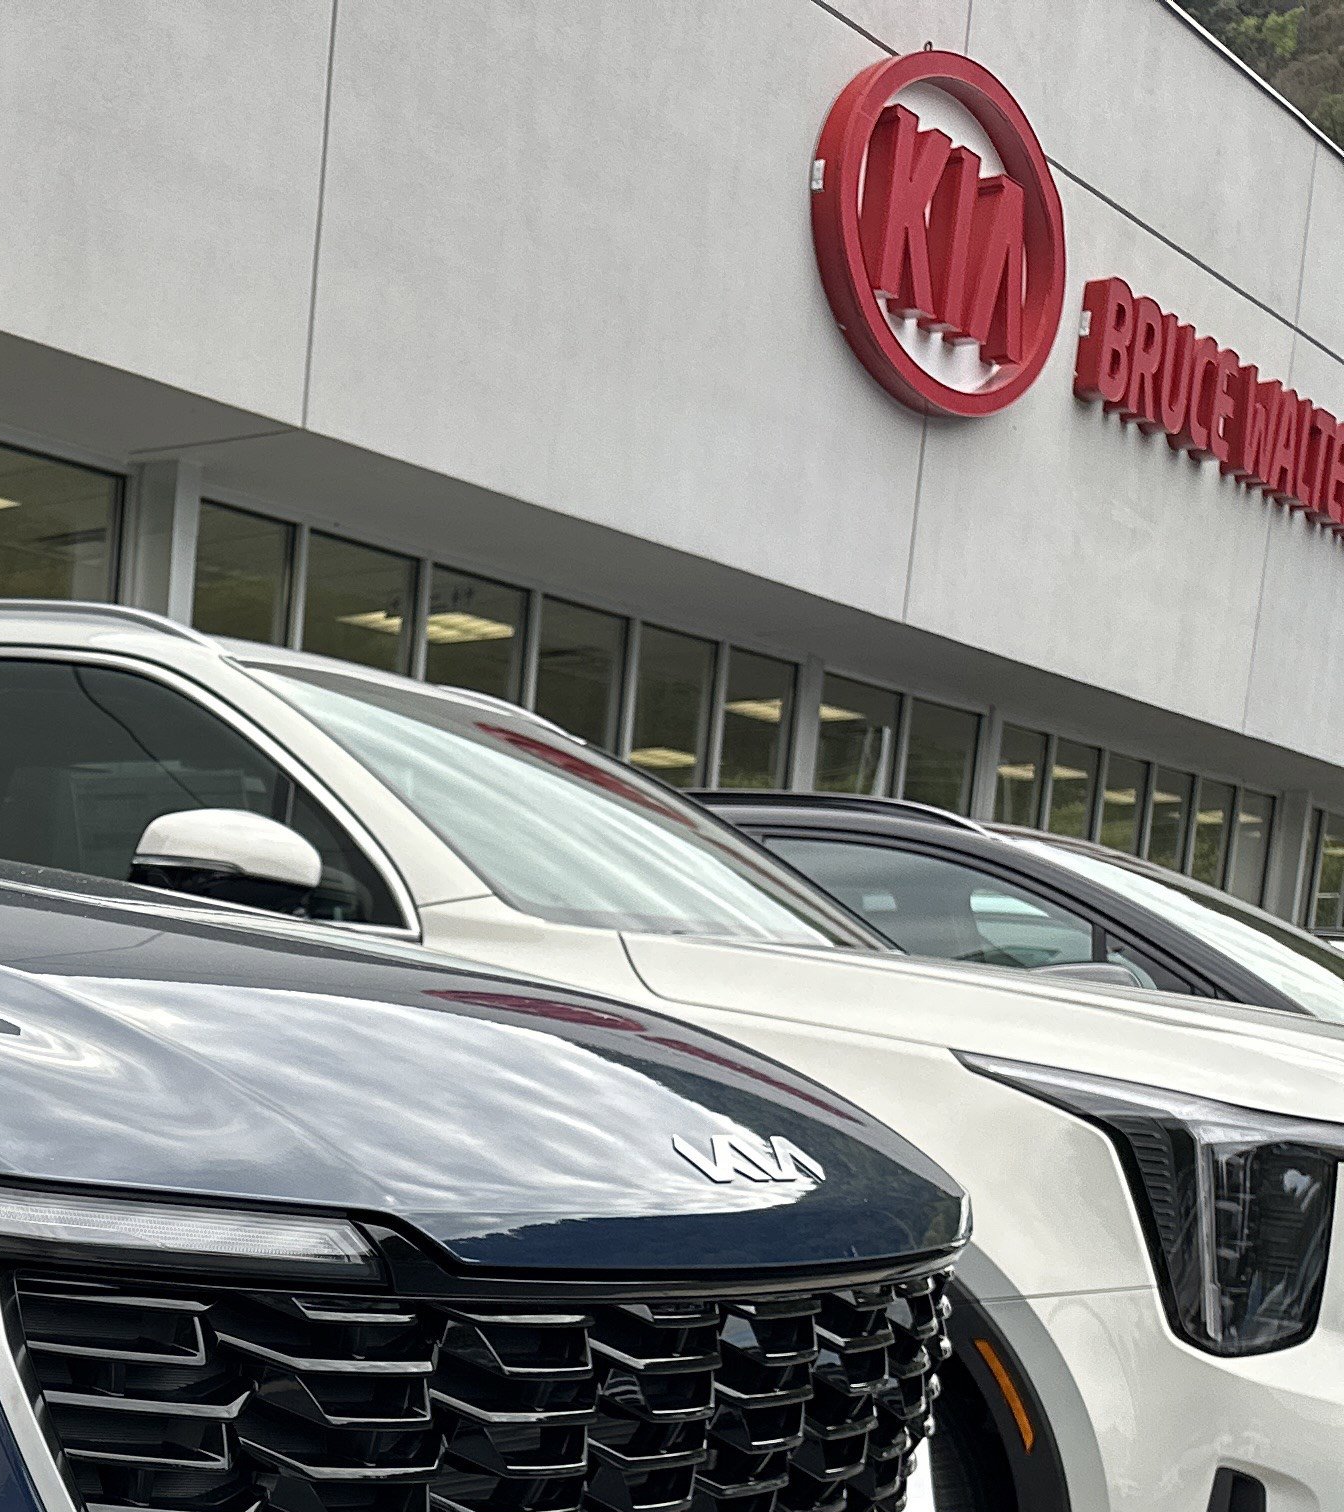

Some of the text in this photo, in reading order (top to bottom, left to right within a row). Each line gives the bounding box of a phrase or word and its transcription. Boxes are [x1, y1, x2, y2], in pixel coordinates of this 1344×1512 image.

[861, 103, 1025, 366] KIA
[1075, 276, 1244, 468] BRUCE
[671, 1133, 826, 1184] KIA
